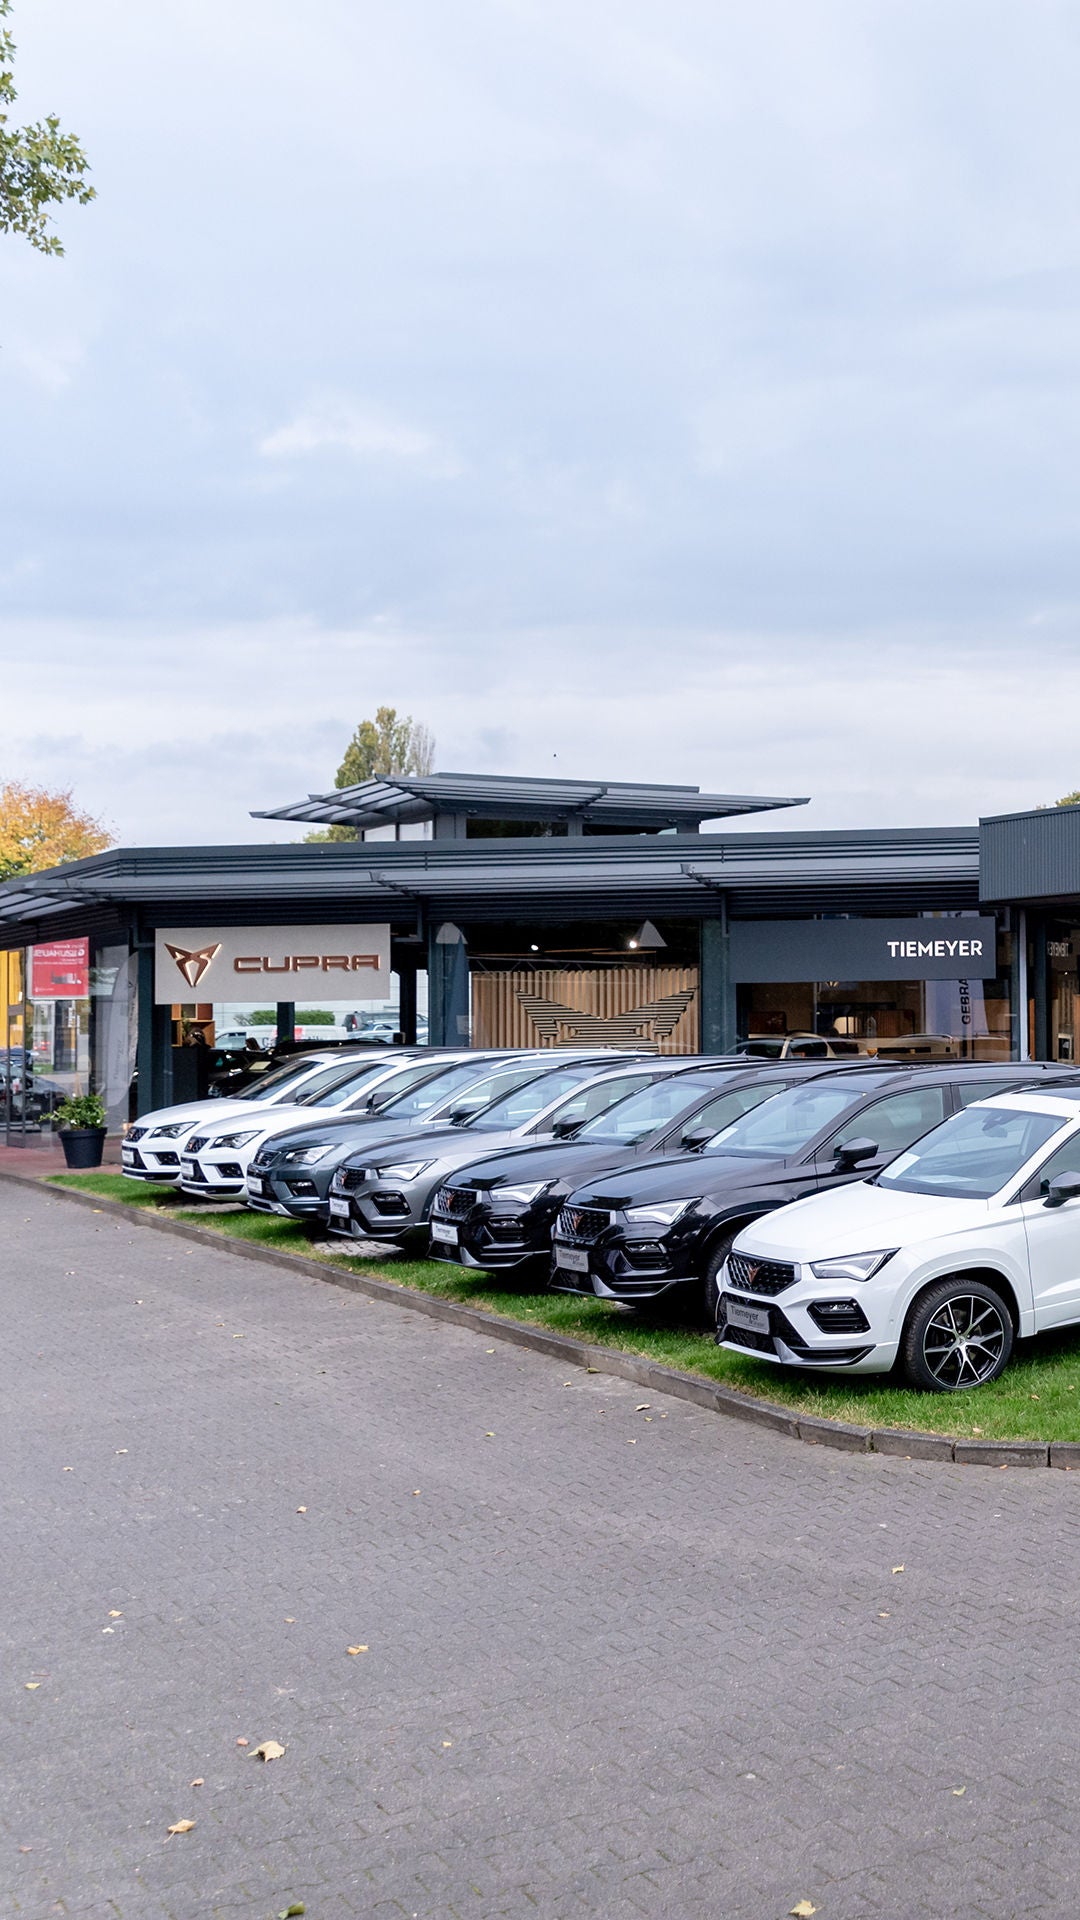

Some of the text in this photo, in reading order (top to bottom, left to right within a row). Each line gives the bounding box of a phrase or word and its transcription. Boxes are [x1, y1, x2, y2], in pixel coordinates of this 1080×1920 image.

[887, 940, 983, 957] TIEMEYER
[234, 954, 380, 974] CUPRA
[730, 1304, 759, 1324] Tiemeyer
